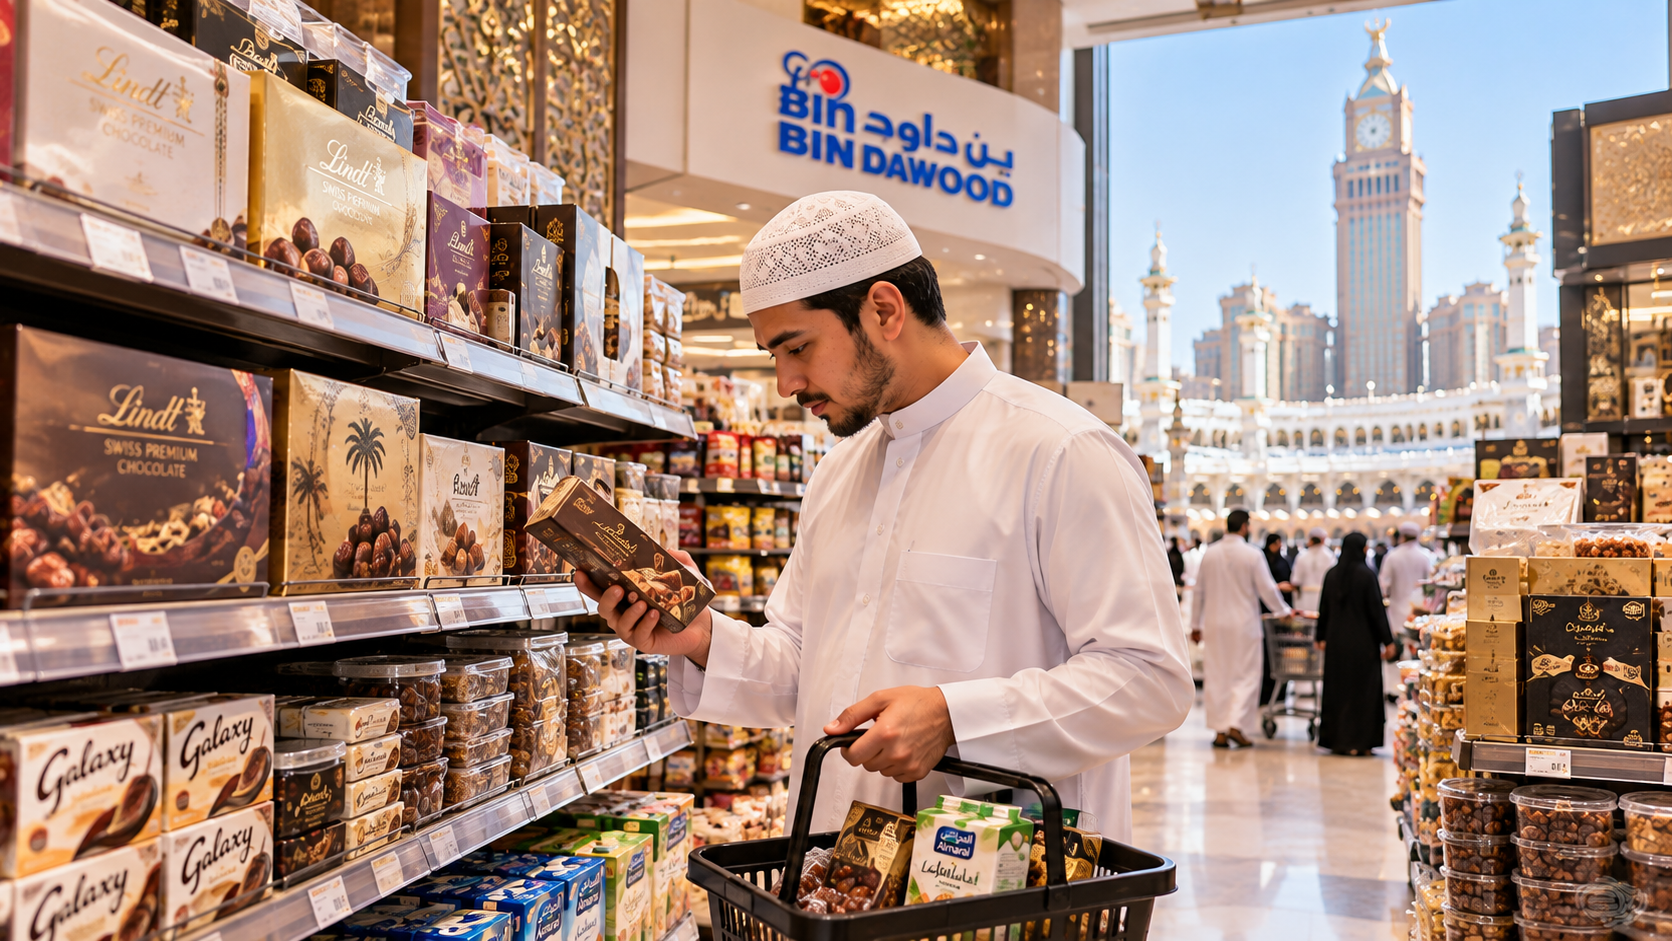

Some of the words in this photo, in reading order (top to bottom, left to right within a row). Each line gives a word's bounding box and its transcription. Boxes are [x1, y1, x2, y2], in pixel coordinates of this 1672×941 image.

[81, 46, 170, 110] Lindt
[319, 139, 373, 188] Lindt
[779, 121, 854, 169] BIN
[862, 143, 1013, 208] DAWOOD
[863, 111, 959, 155] داود
[97, 384, 183, 432] Lindt
[104, 438, 142, 457] SWISS
[145, 443, 198, 462] PREMIUM
[117, 459, 186, 478] CHOCOLATE
[37, 738, 134, 818] Galaxy
[180, 714, 254, 782] Galaxy
[181, 826, 253, 896] Galaxy
[30, 868, 129, 941] Galaxy
